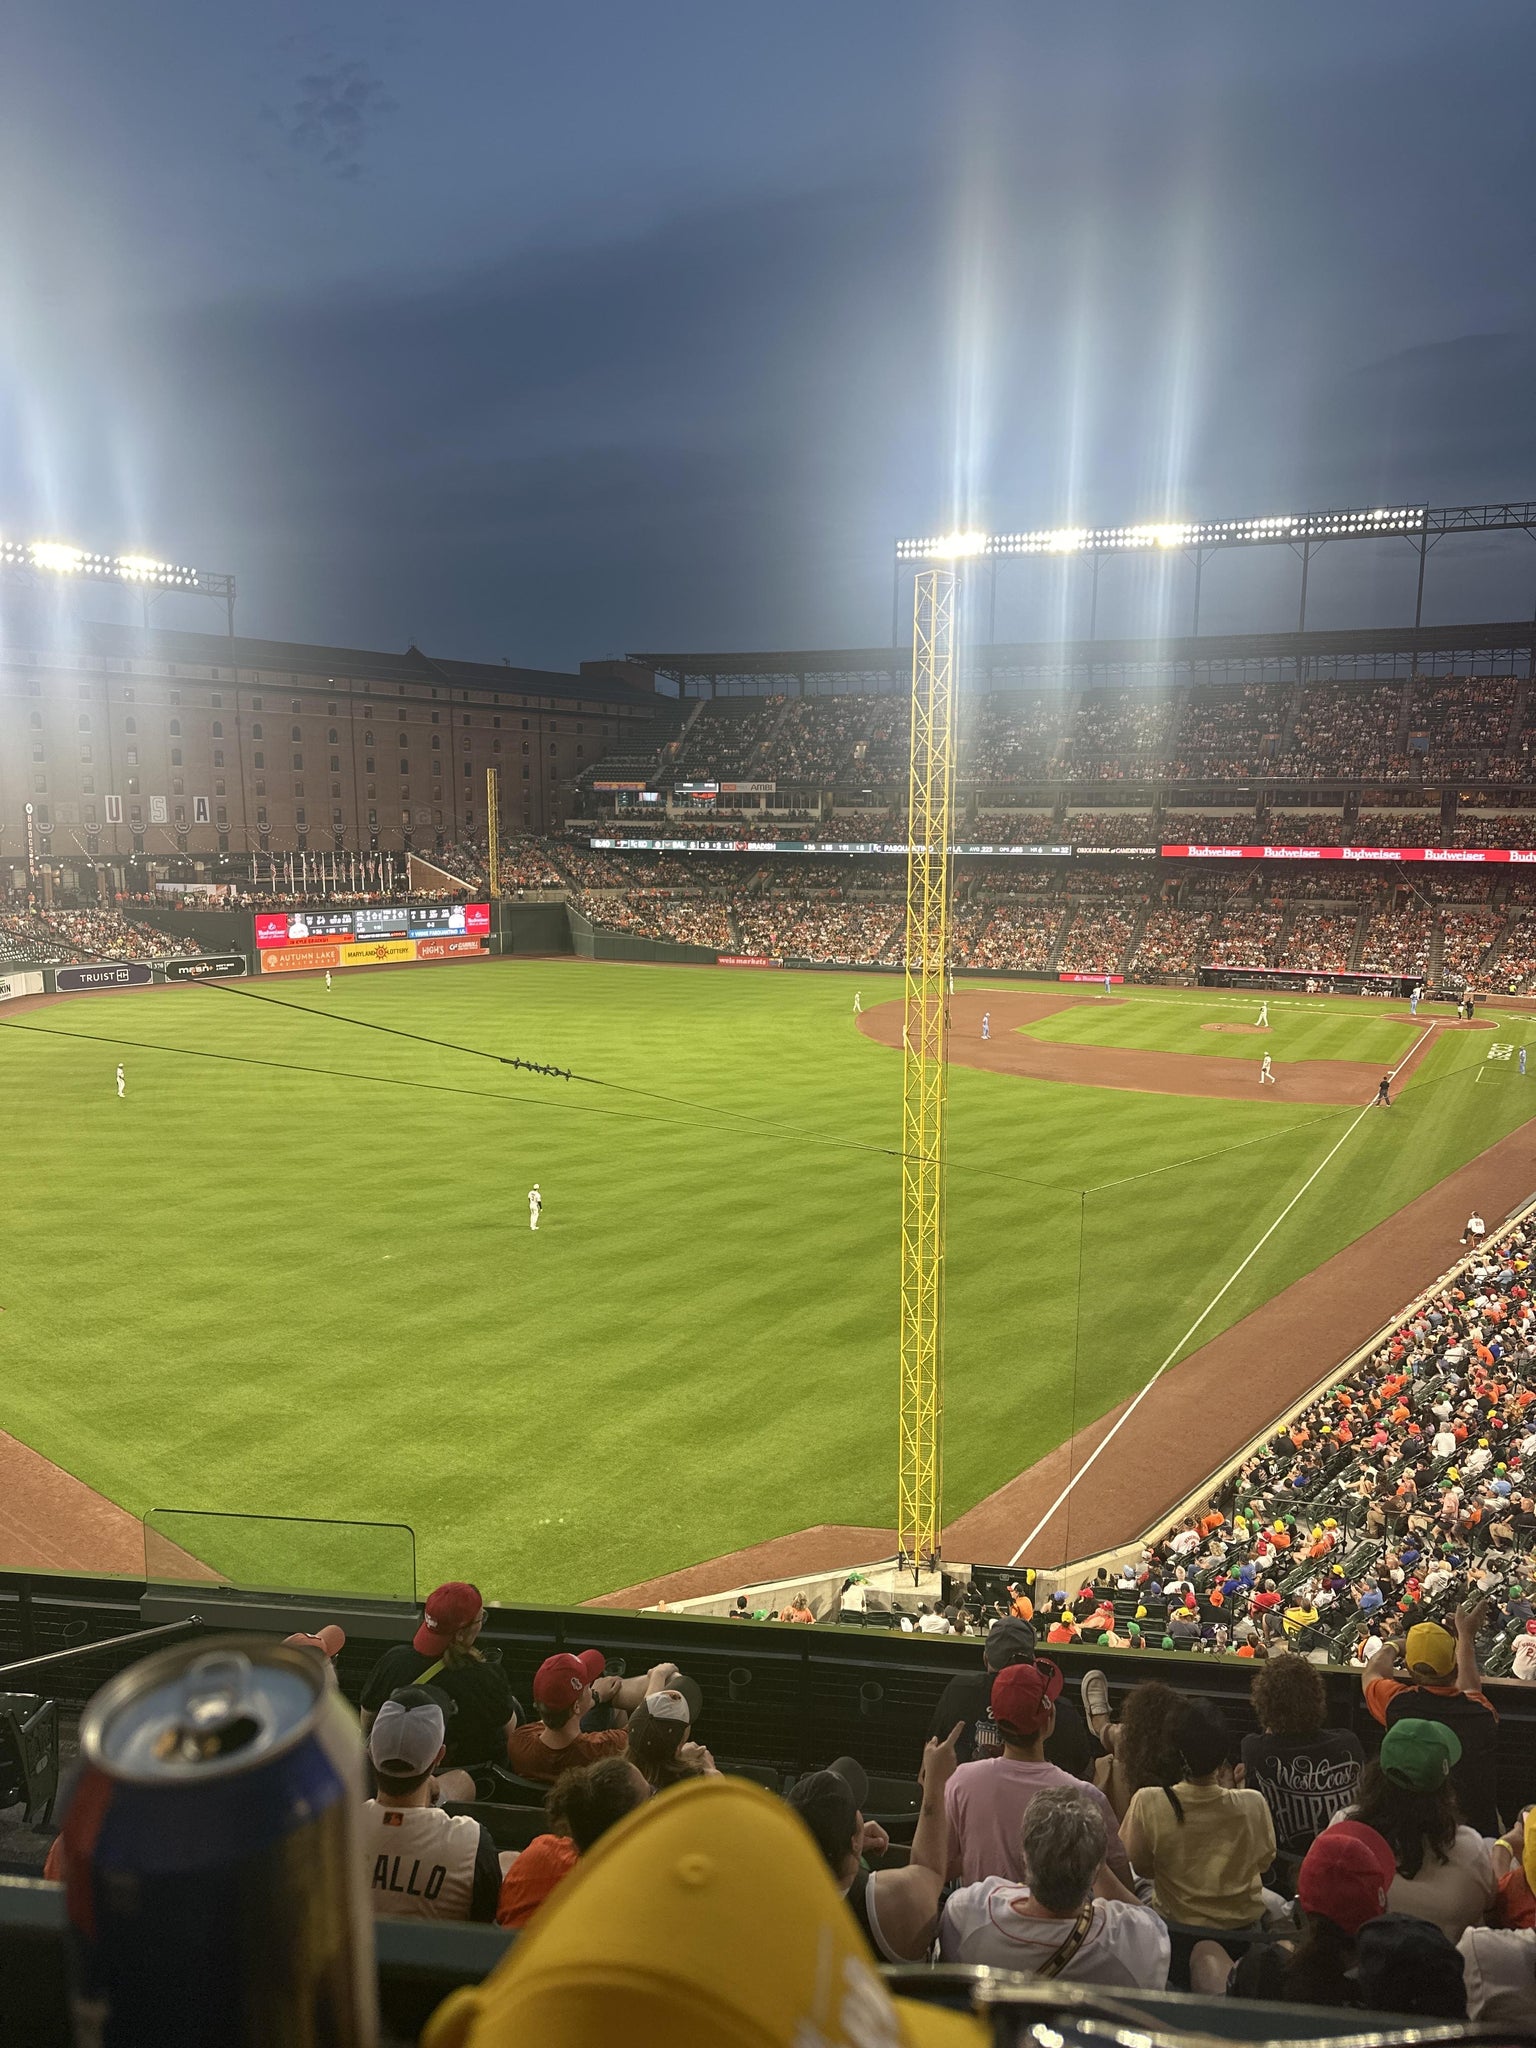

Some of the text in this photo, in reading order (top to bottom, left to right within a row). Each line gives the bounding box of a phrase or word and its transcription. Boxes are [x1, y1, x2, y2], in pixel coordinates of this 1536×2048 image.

[280, 950, 336, 962] AUTUMN LAKE
[347, 947, 409, 958] MARYLAND LOTTERY
[79, 972, 115, 983] TRUIST
